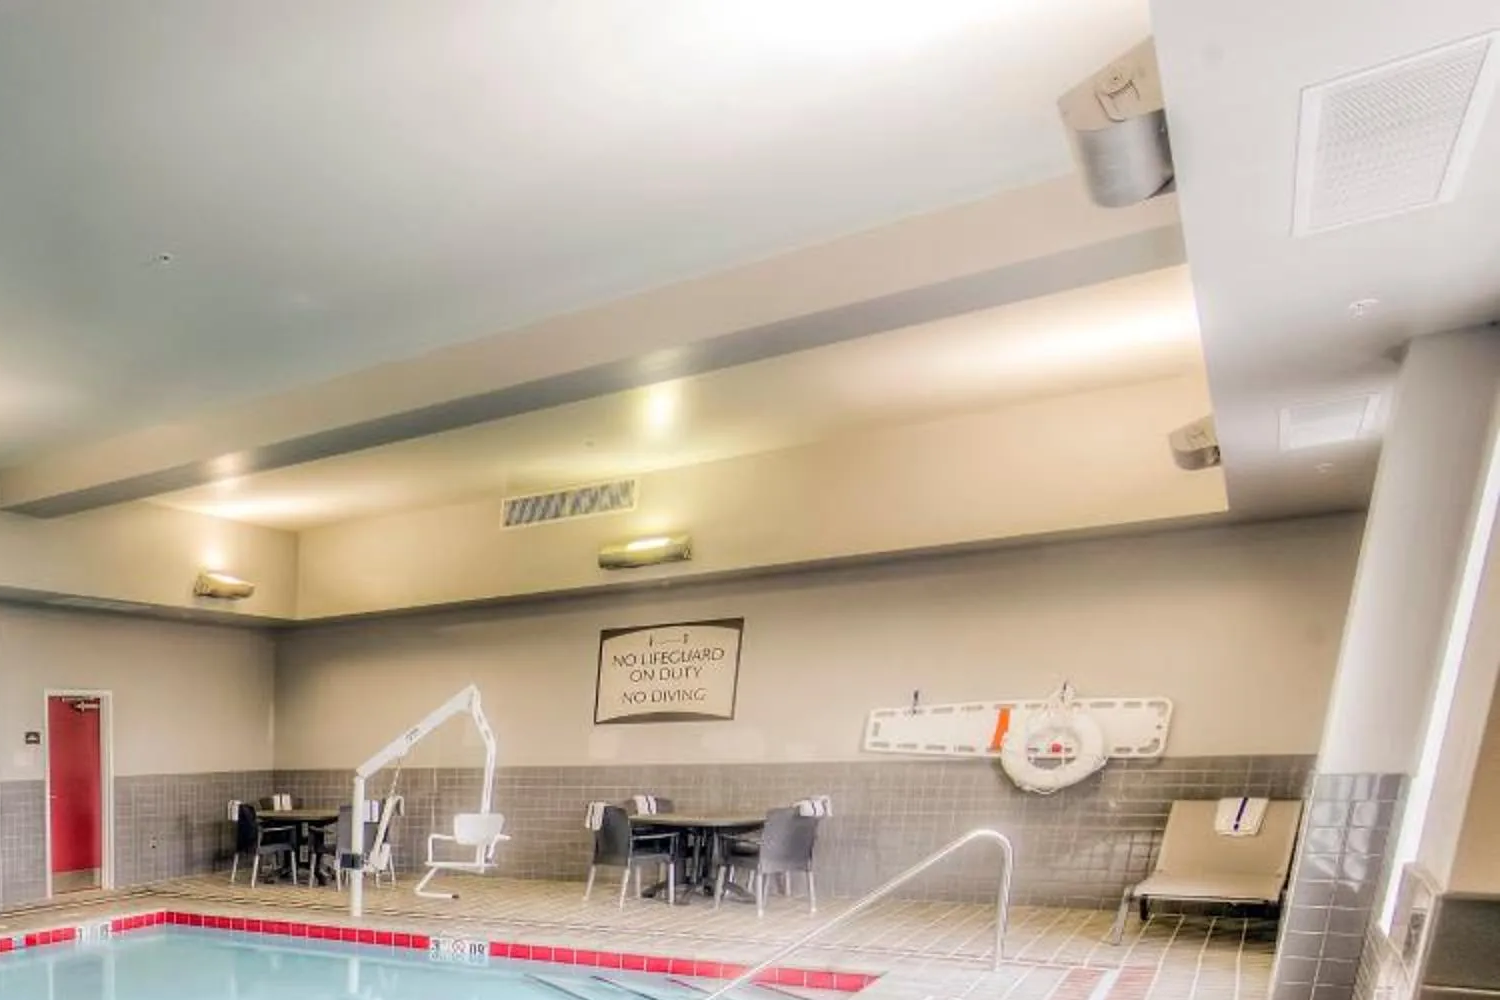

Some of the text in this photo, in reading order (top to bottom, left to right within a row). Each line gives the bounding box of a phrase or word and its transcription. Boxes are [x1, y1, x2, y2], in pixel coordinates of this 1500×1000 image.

[613, 647, 725, 668] NO LIFEGUARD
[630, 665, 703, 683] ON DUTY
[622, 688, 708, 705] NO DIVING
